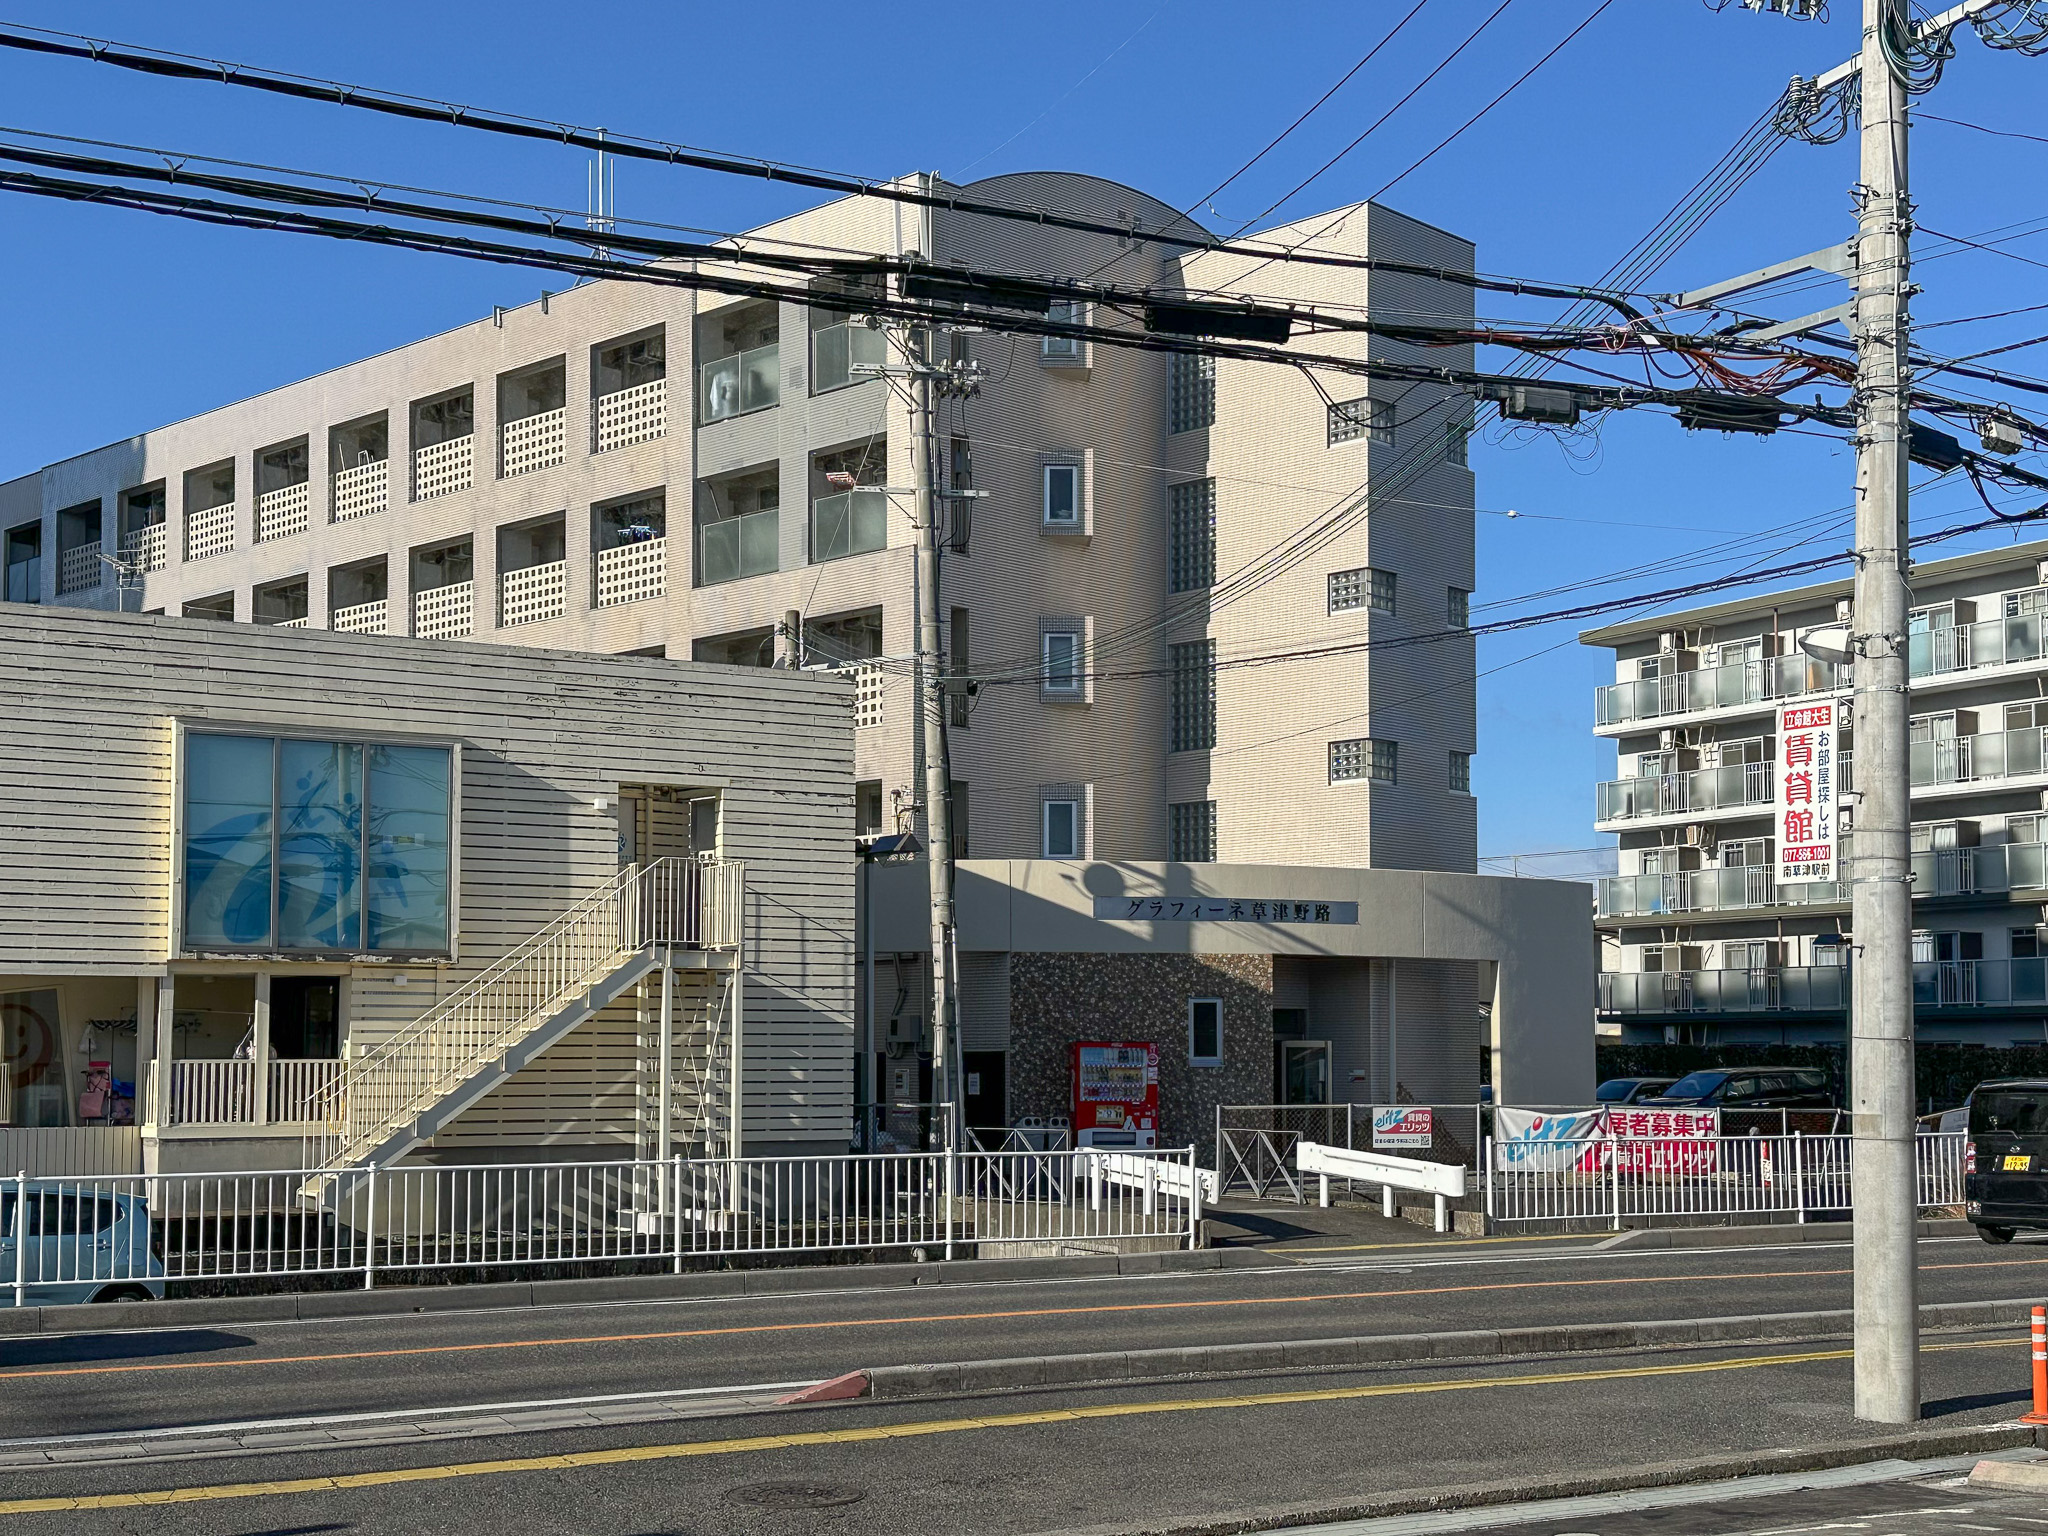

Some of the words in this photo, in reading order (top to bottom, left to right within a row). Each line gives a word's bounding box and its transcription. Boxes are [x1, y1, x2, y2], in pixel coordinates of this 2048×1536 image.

[1785, 708, 1829, 728] 立命館大生
[1784, 732, 1813, 843] 賃貸館
[1818, 731, 1830, 840] お部屋探しは
[1783, 863, 1830, 878] 南草津駅前
[1127, 900, 1331, 922] グラフィーネ草津野路
[1400, 1123, 1430, 1132] エリッツ
[1587, 1112, 1715, 1137] 入居者募集中
